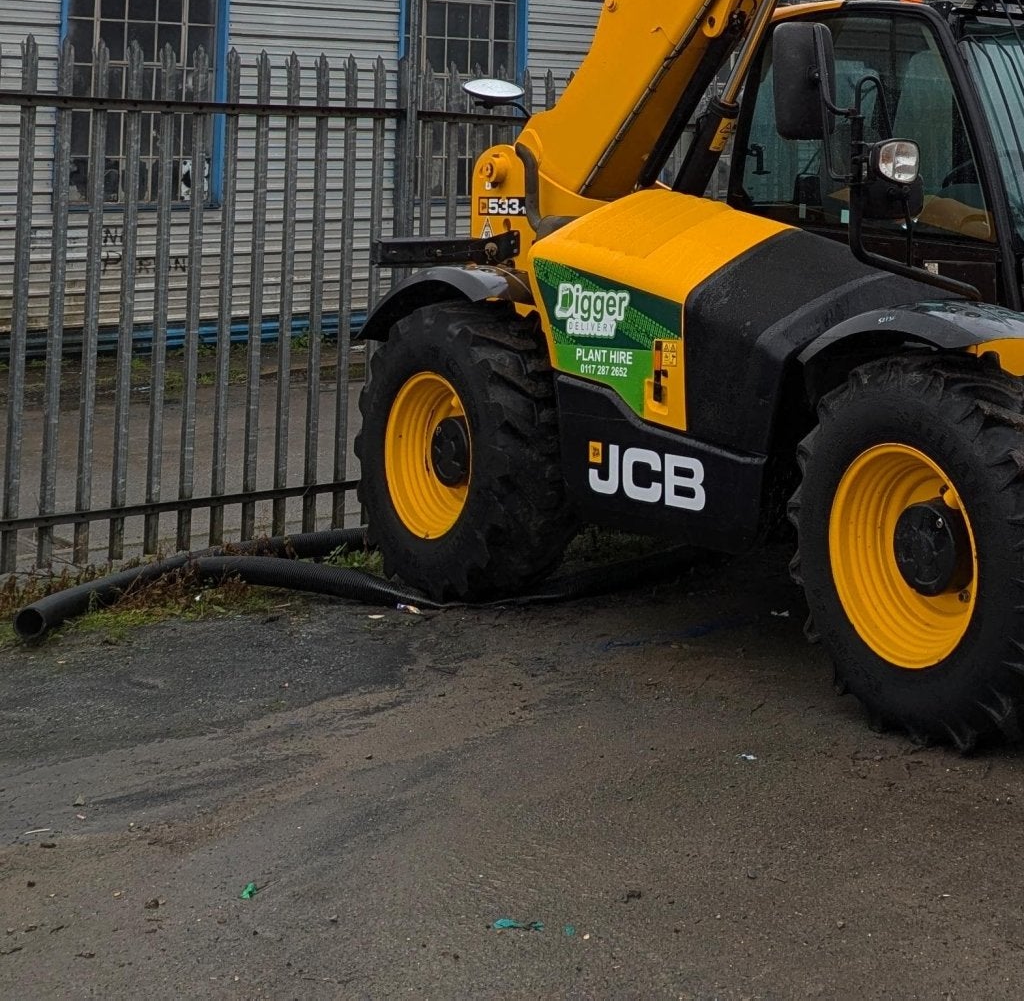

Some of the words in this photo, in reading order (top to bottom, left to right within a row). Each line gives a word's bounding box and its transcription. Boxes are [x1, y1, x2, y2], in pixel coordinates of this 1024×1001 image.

[556, 284, 628, 322] Digger
[568, 321, 616, 333] DELIVERY
[576, 348, 607, 363] PLANT
[609, 350, 633, 365] HIRE
[580, 364, 596, 374] 0117
[597, 365, 610, 375] 287
[611, 366, 628, 378] 2652
[588, 444, 706, 511] JCB
